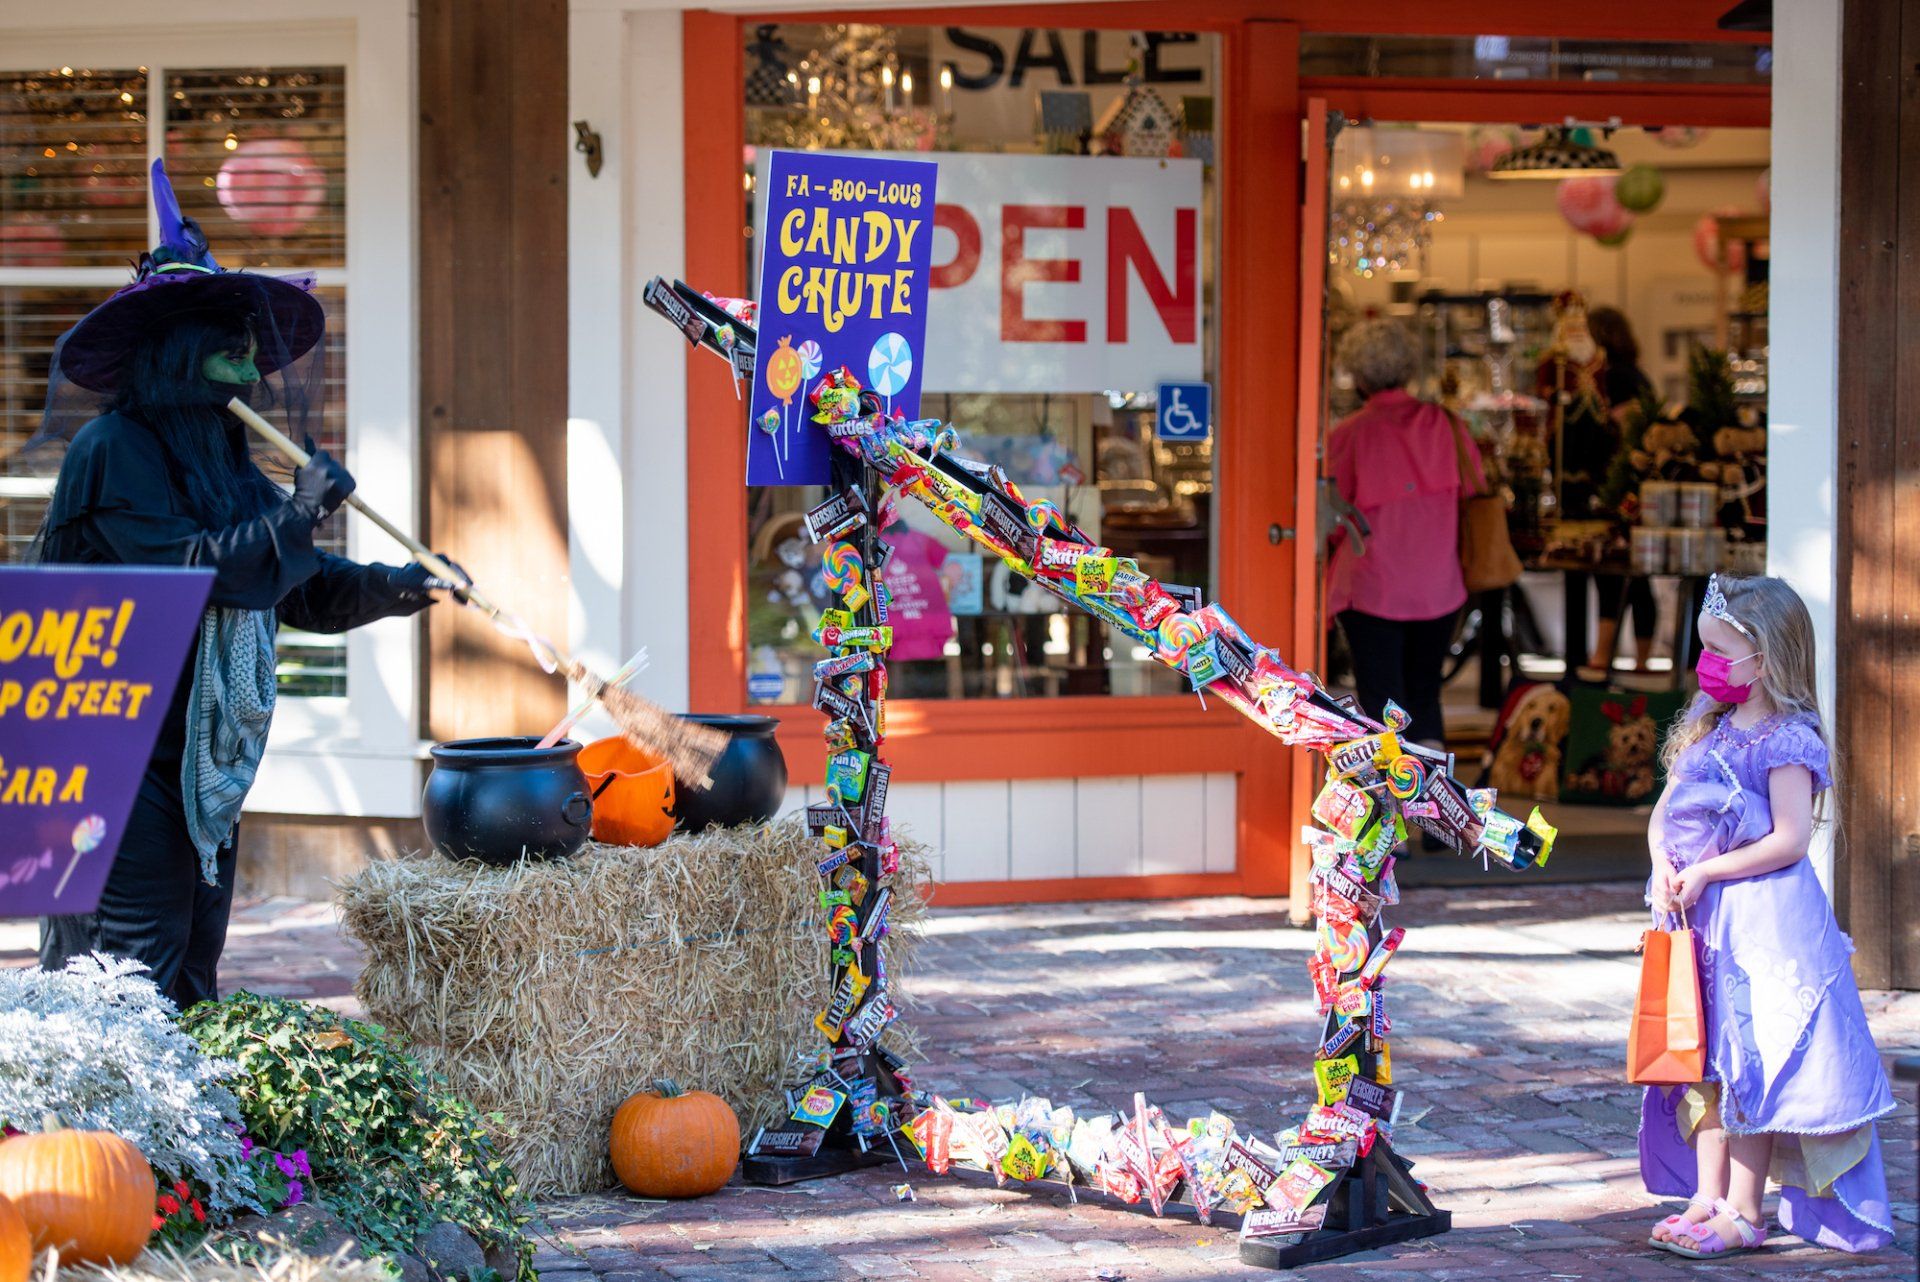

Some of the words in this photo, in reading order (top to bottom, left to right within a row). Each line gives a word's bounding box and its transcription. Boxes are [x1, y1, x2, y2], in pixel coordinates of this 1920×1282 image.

[945, 26, 1203, 90] SALE
[779, 206, 922, 265] CANDY
[929, 204, 1197, 345] PEN
[777, 265, 915, 334] CHUTE
[809, 496, 849, 530] HERSHEY'S
[985, 500, 1022, 542] HERSHEY'S
[1042, 548, 1082, 566] Skitt
[0, 599, 135, 679] OME!
[24, 680, 58, 720] 6
[55, 681, 153, 720] FEET
[59, 764, 89, 803] A
[1428, 779, 1470, 829] HERSHEY'S
[1351, 1078, 1385, 1105] HERSHEY'S
[761, 1131, 805, 1146] HERSHEY'S
[1306, 1112, 1366, 1138] Skittles
[1250, 1209, 1301, 1227] HERSHEY'S
